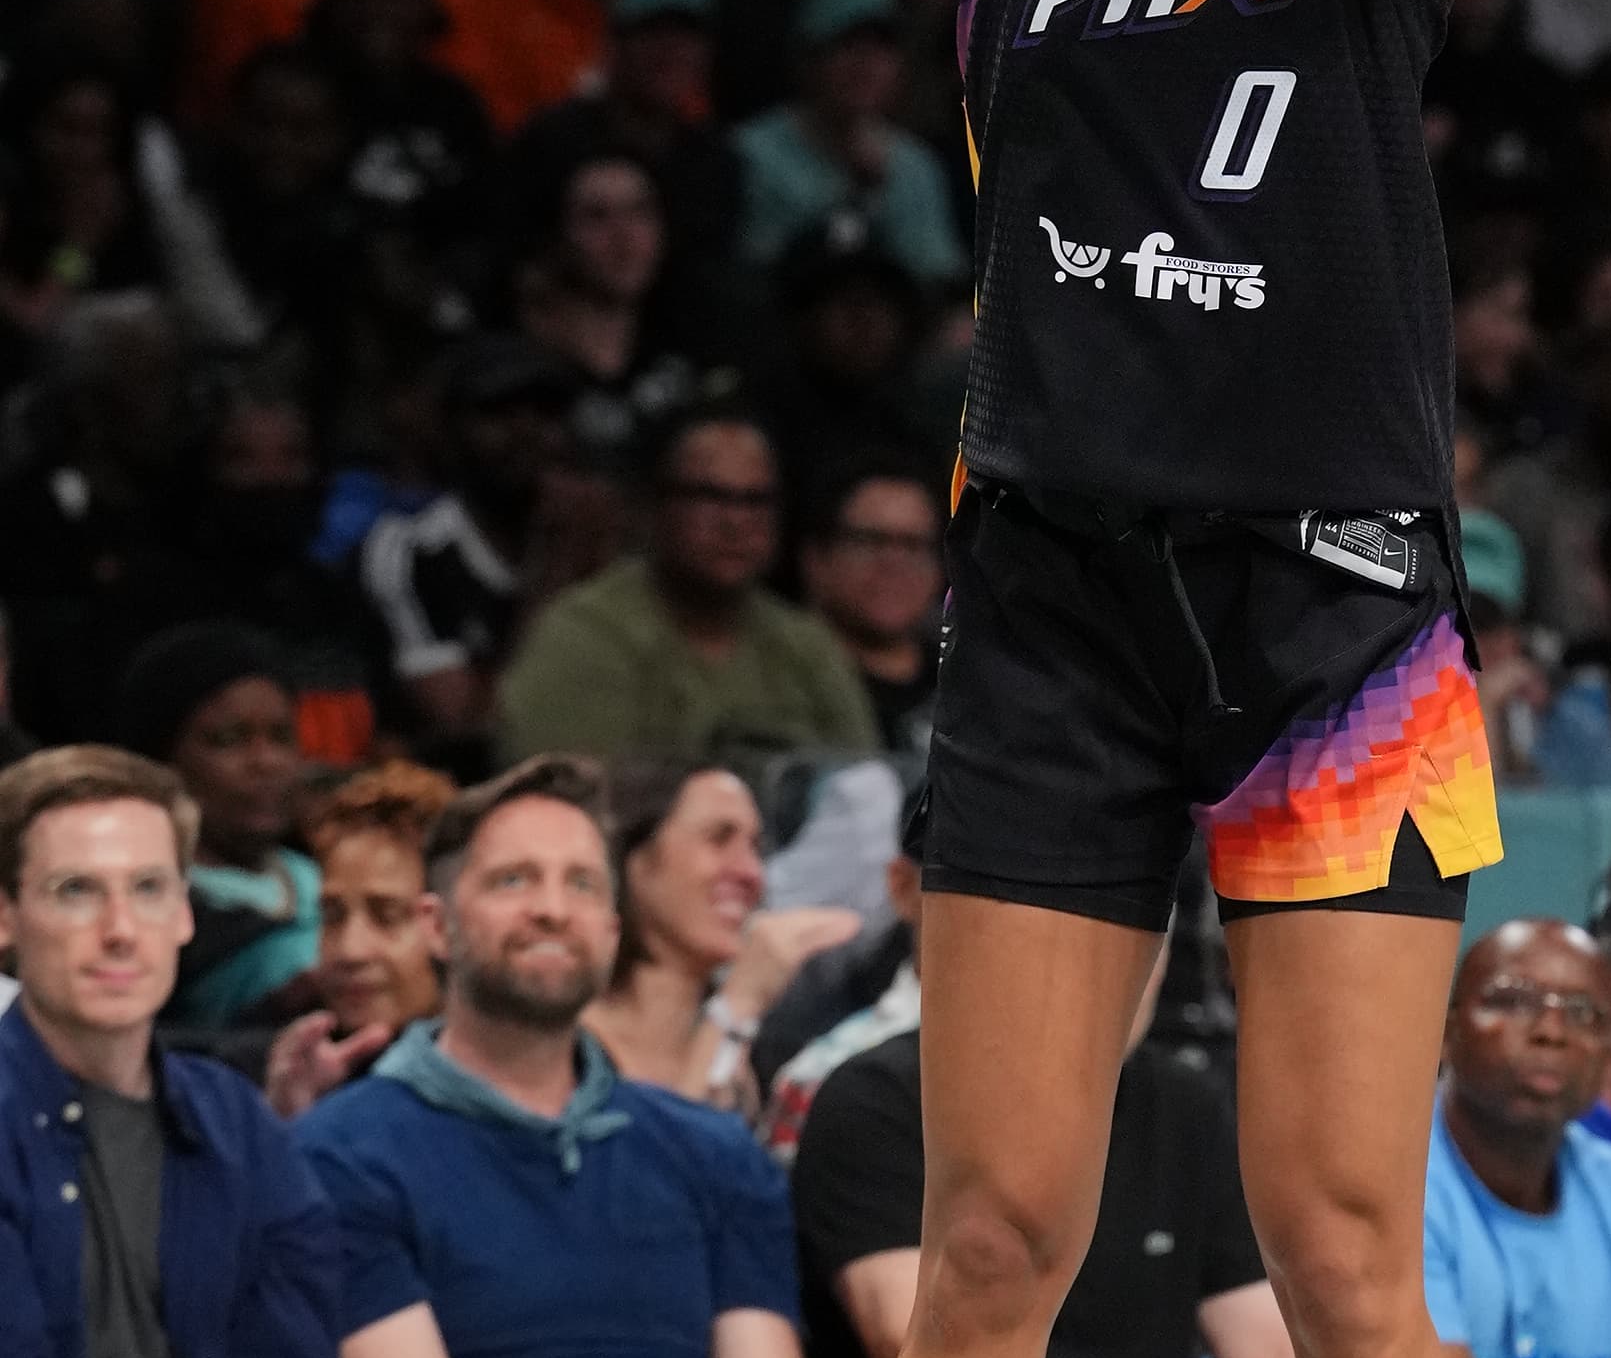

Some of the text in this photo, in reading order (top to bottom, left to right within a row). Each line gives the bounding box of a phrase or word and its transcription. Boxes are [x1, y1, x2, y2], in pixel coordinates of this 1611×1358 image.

[1200, 70, 1298, 190] 0
[1120, 232, 1266, 311] fry's
[1165, 257, 1251, 275] FOOD STORES
